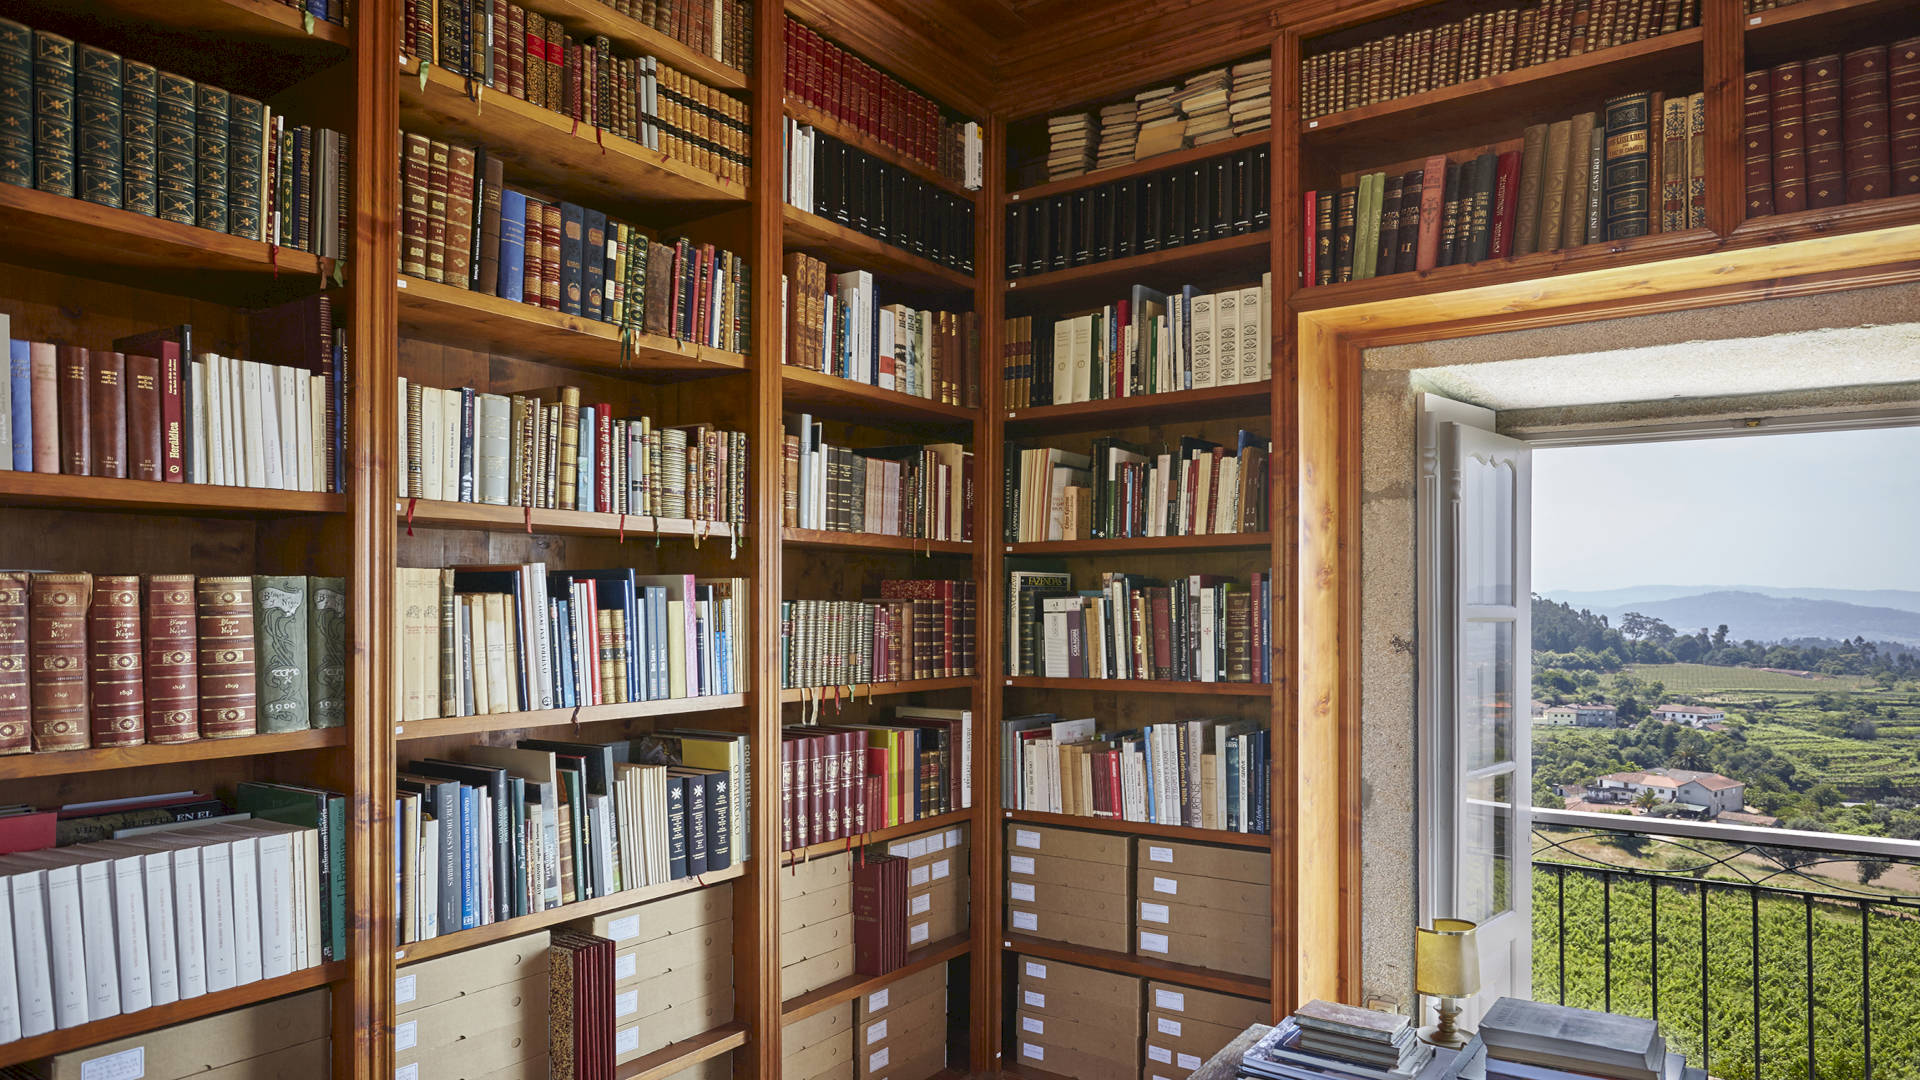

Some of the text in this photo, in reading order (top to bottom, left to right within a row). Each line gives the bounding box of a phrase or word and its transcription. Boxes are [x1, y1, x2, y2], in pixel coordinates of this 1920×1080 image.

[1592, 158, 1600, 191] CASTRO
[1592, 198, 1598, 208] DE
[168, 422, 179, 458] Heráldica
[270, 702, 296, 712] 1900
[177, 812, 194, 822] EN
[198, 810, 213, 819] EL
